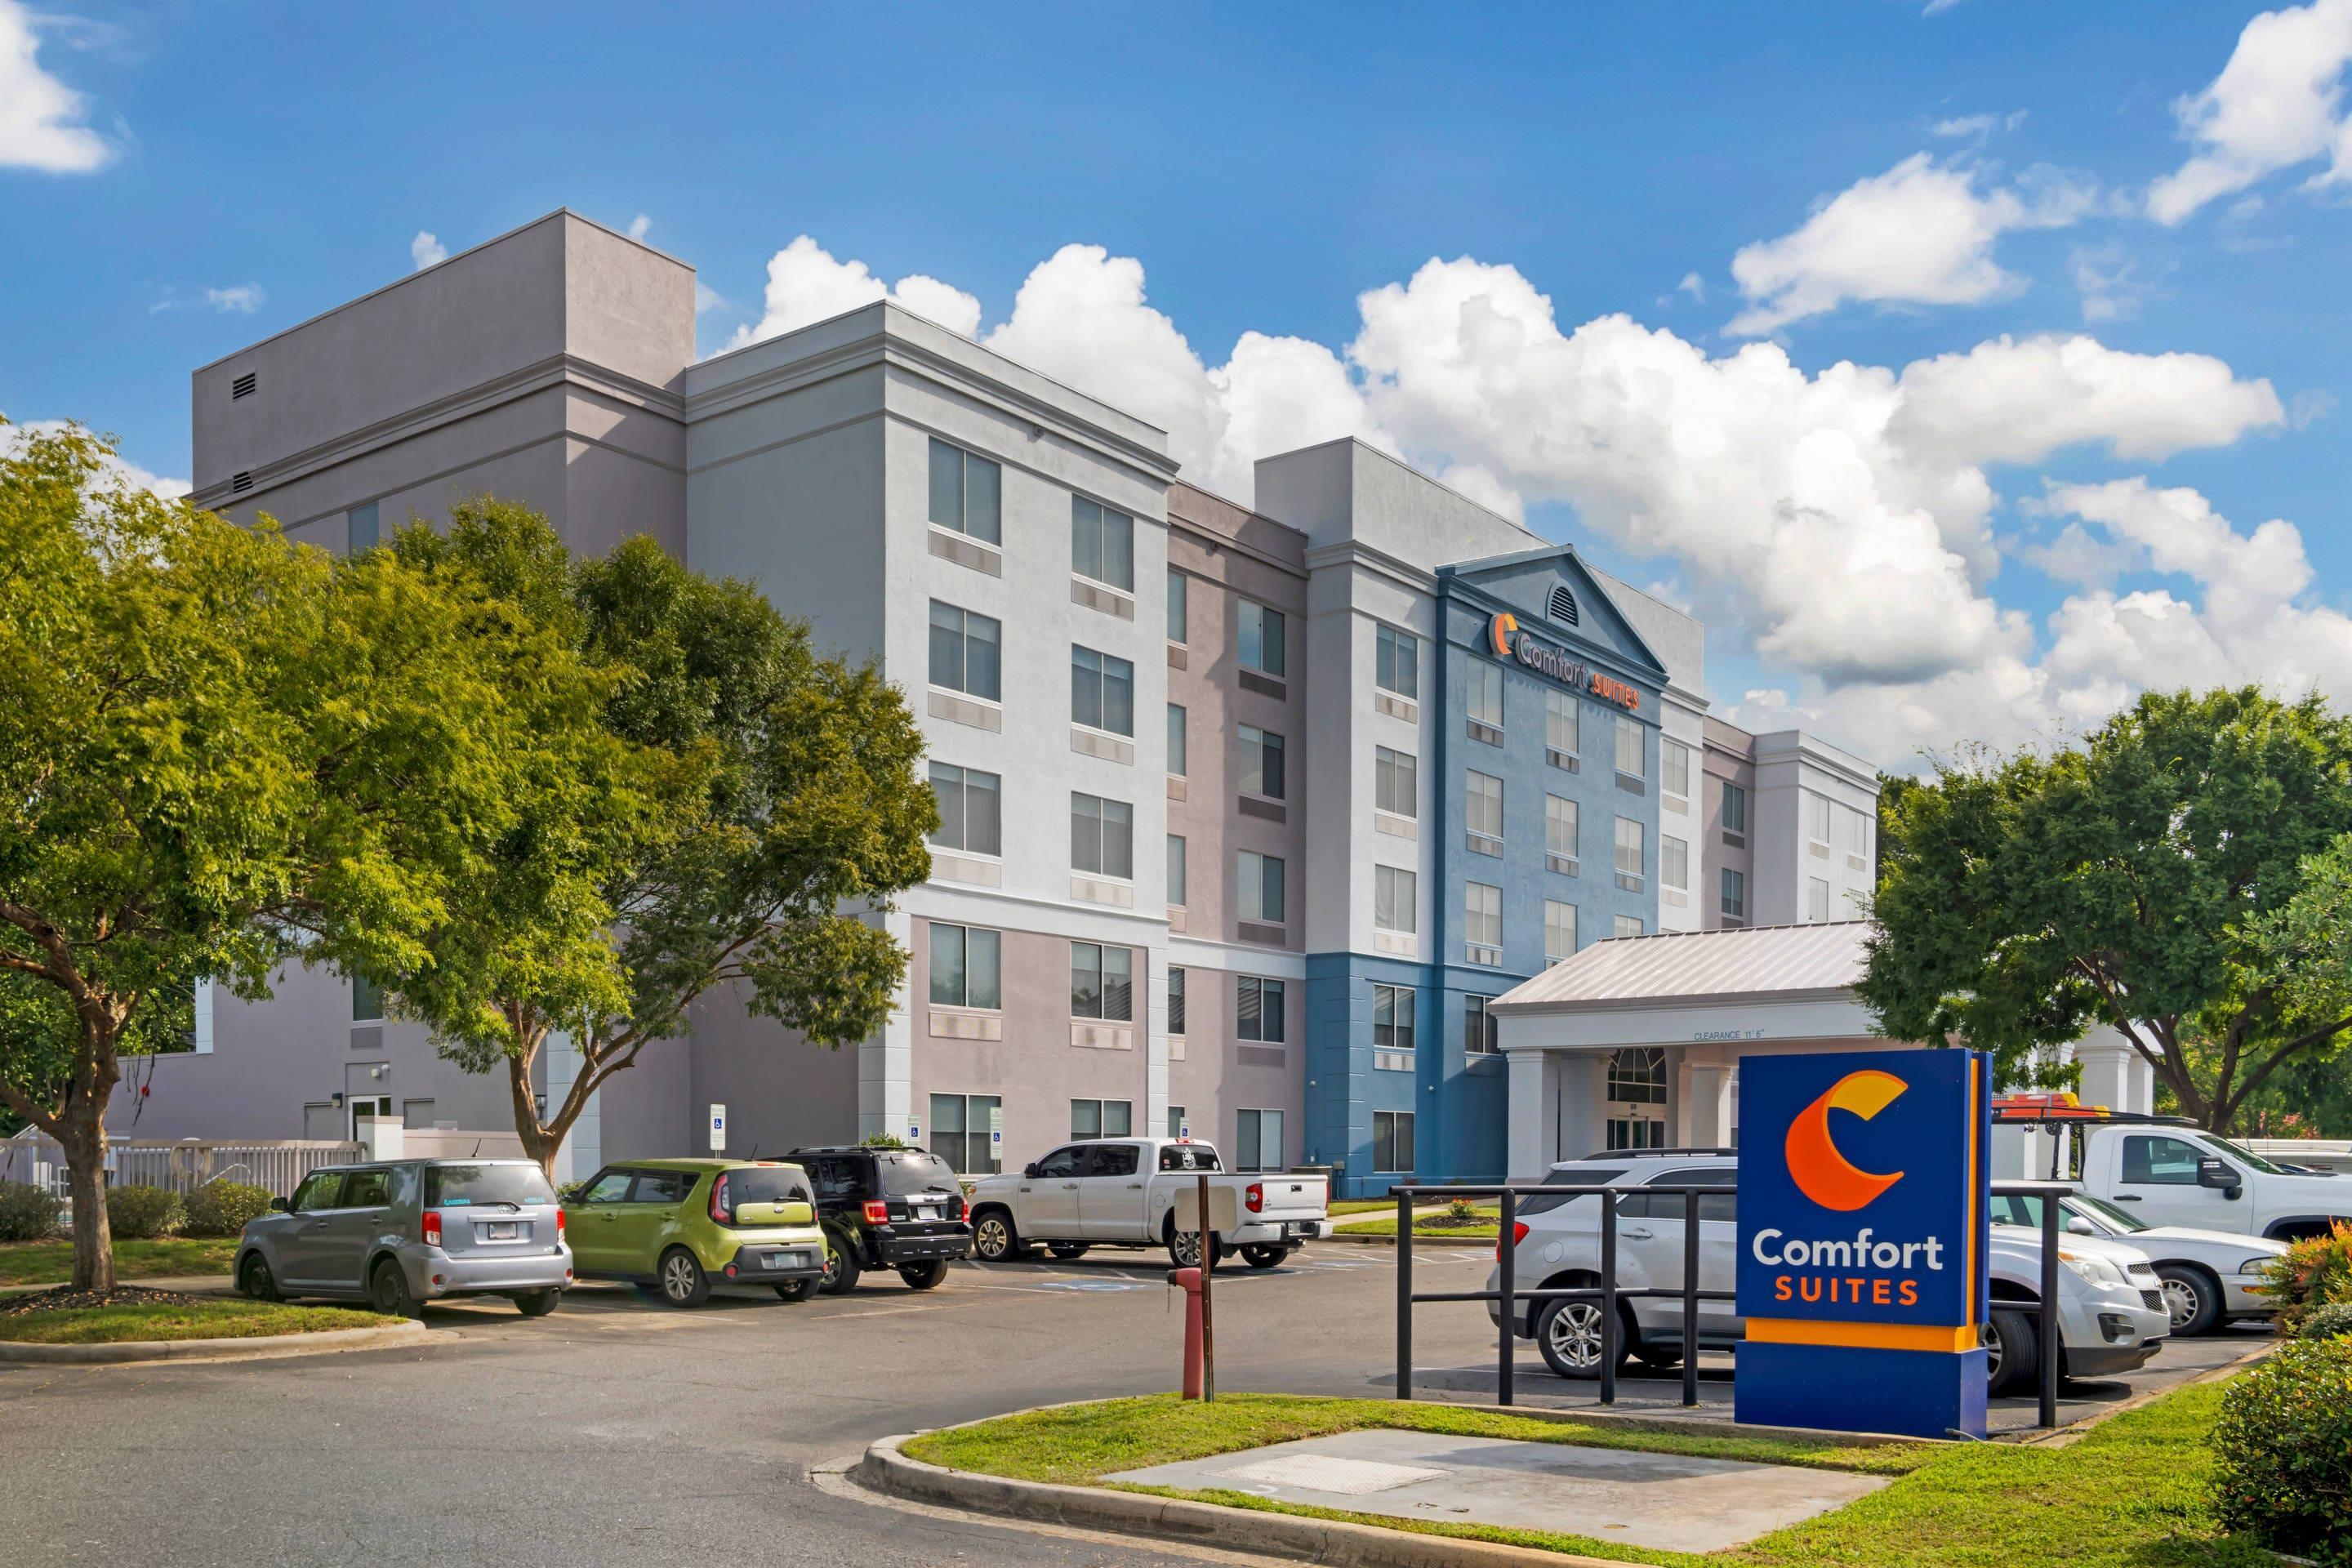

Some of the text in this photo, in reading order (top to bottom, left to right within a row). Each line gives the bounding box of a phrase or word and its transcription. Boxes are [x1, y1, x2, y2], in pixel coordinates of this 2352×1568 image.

[1515, 632, 1640, 710] Comfort SUITES
[1694, 1030, 1740, 1040] CLEARANCE
[1753, 1227, 1944, 1270] Comfort
[1775, 1275, 1918, 1306] SUITES
